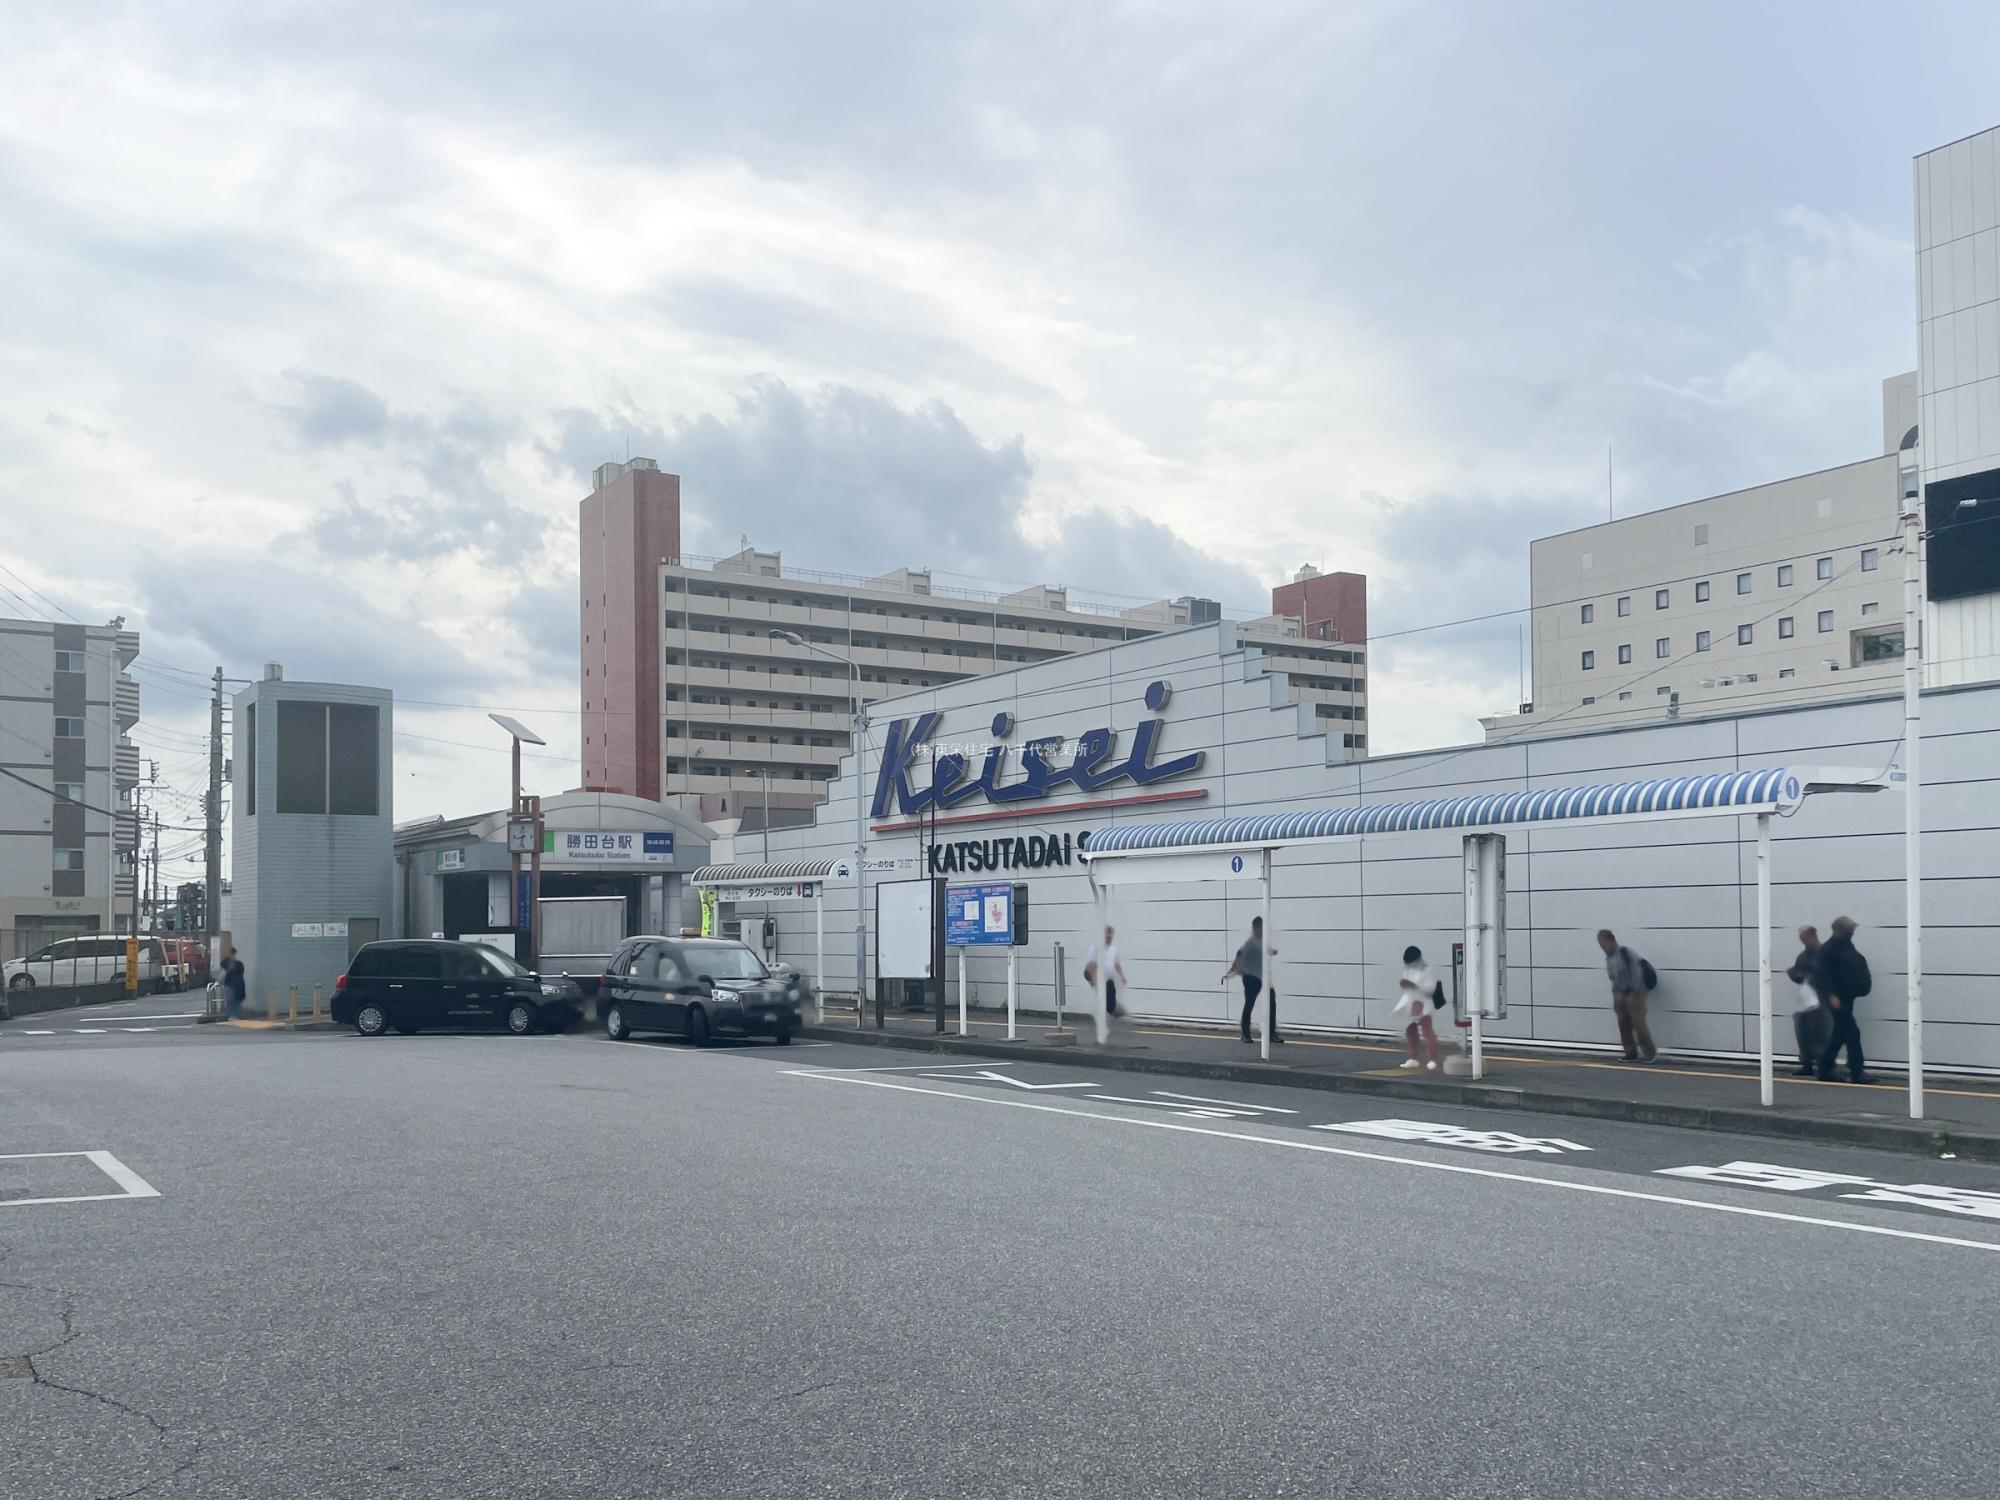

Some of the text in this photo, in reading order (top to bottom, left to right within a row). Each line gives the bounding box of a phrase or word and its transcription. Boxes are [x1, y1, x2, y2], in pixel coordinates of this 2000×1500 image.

[870, 679, 1206, 817] Keisei
[567, 834, 632, 849] 勝田台駅
[568, 851, 631, 859] Katsutadai Station
[928, 832, 1071, 874] KATSUTADAI
[748, 886, 793, 898] タクシーのりば
